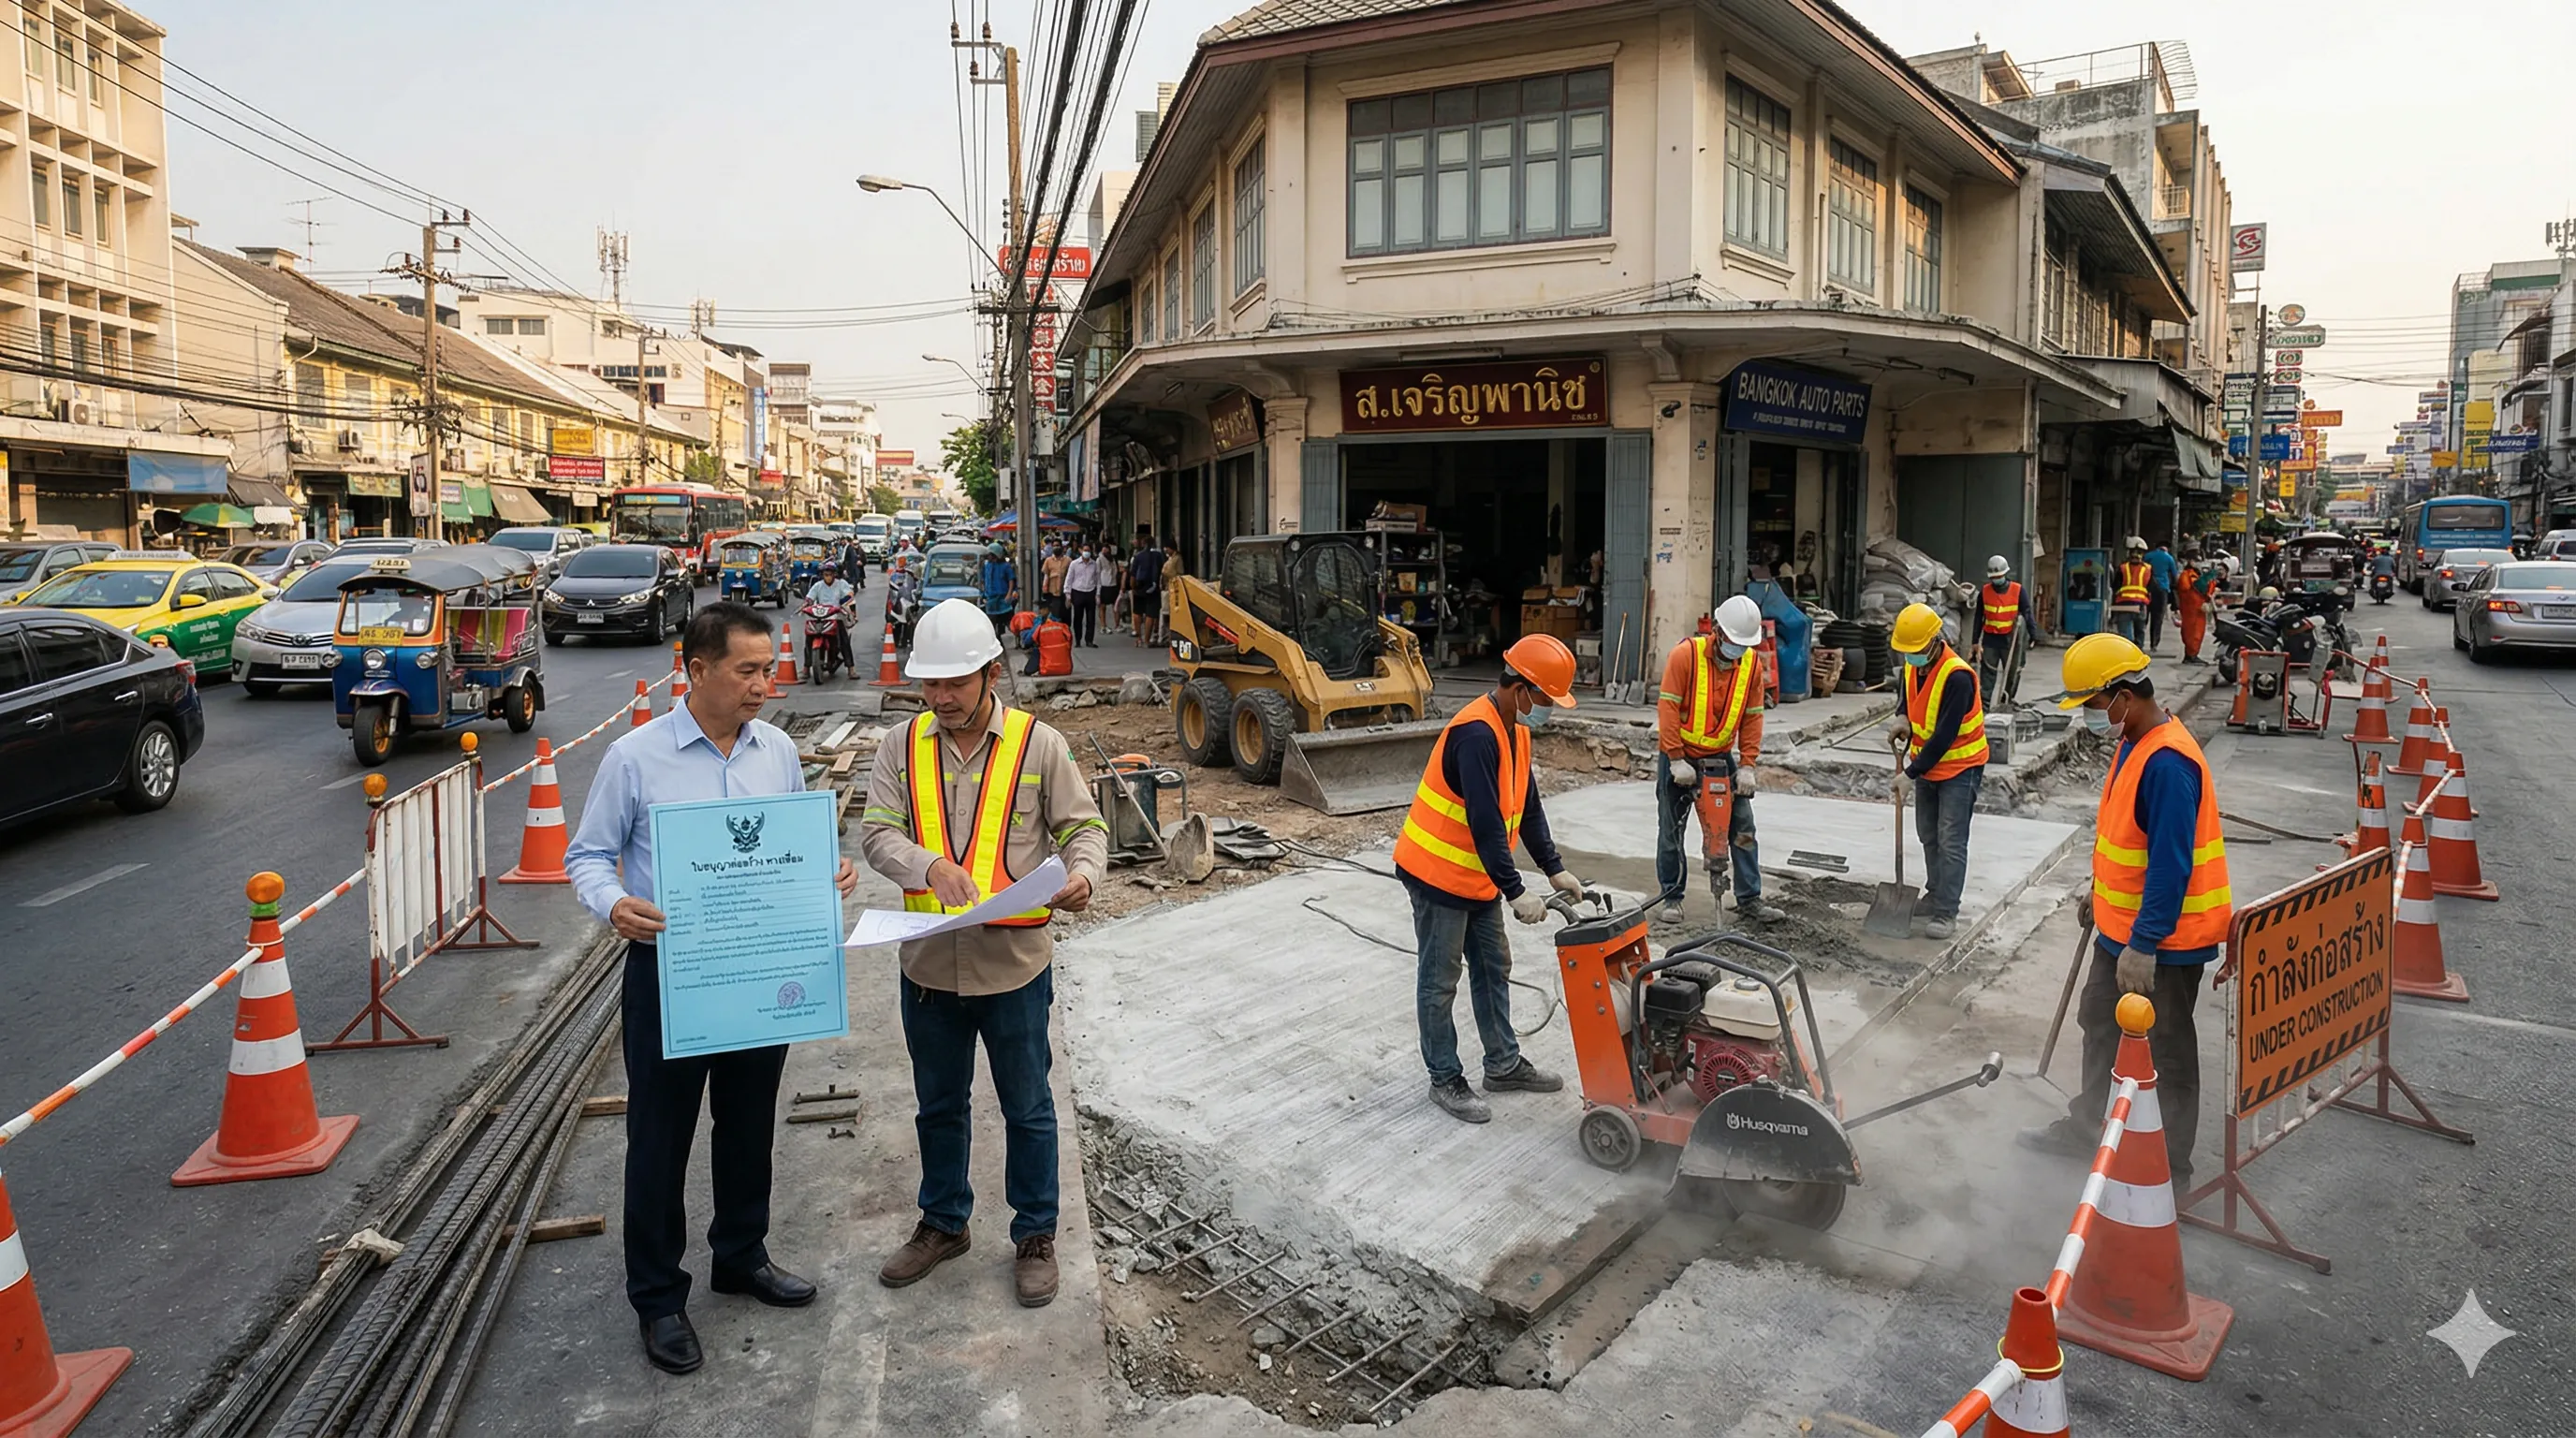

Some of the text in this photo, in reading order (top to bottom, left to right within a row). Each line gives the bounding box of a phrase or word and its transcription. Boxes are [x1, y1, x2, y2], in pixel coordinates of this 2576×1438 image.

[1355, 366, 1587, 425] ส.เจริญพานิช
[1738, 372, 1866, 418] BANGKOK AUTO PARTS
[2249, 901, 2385, 1017] กำลังก่อสร้าง
[2249, 968, 2385, 1064] UNDER CONSTRUCTION
